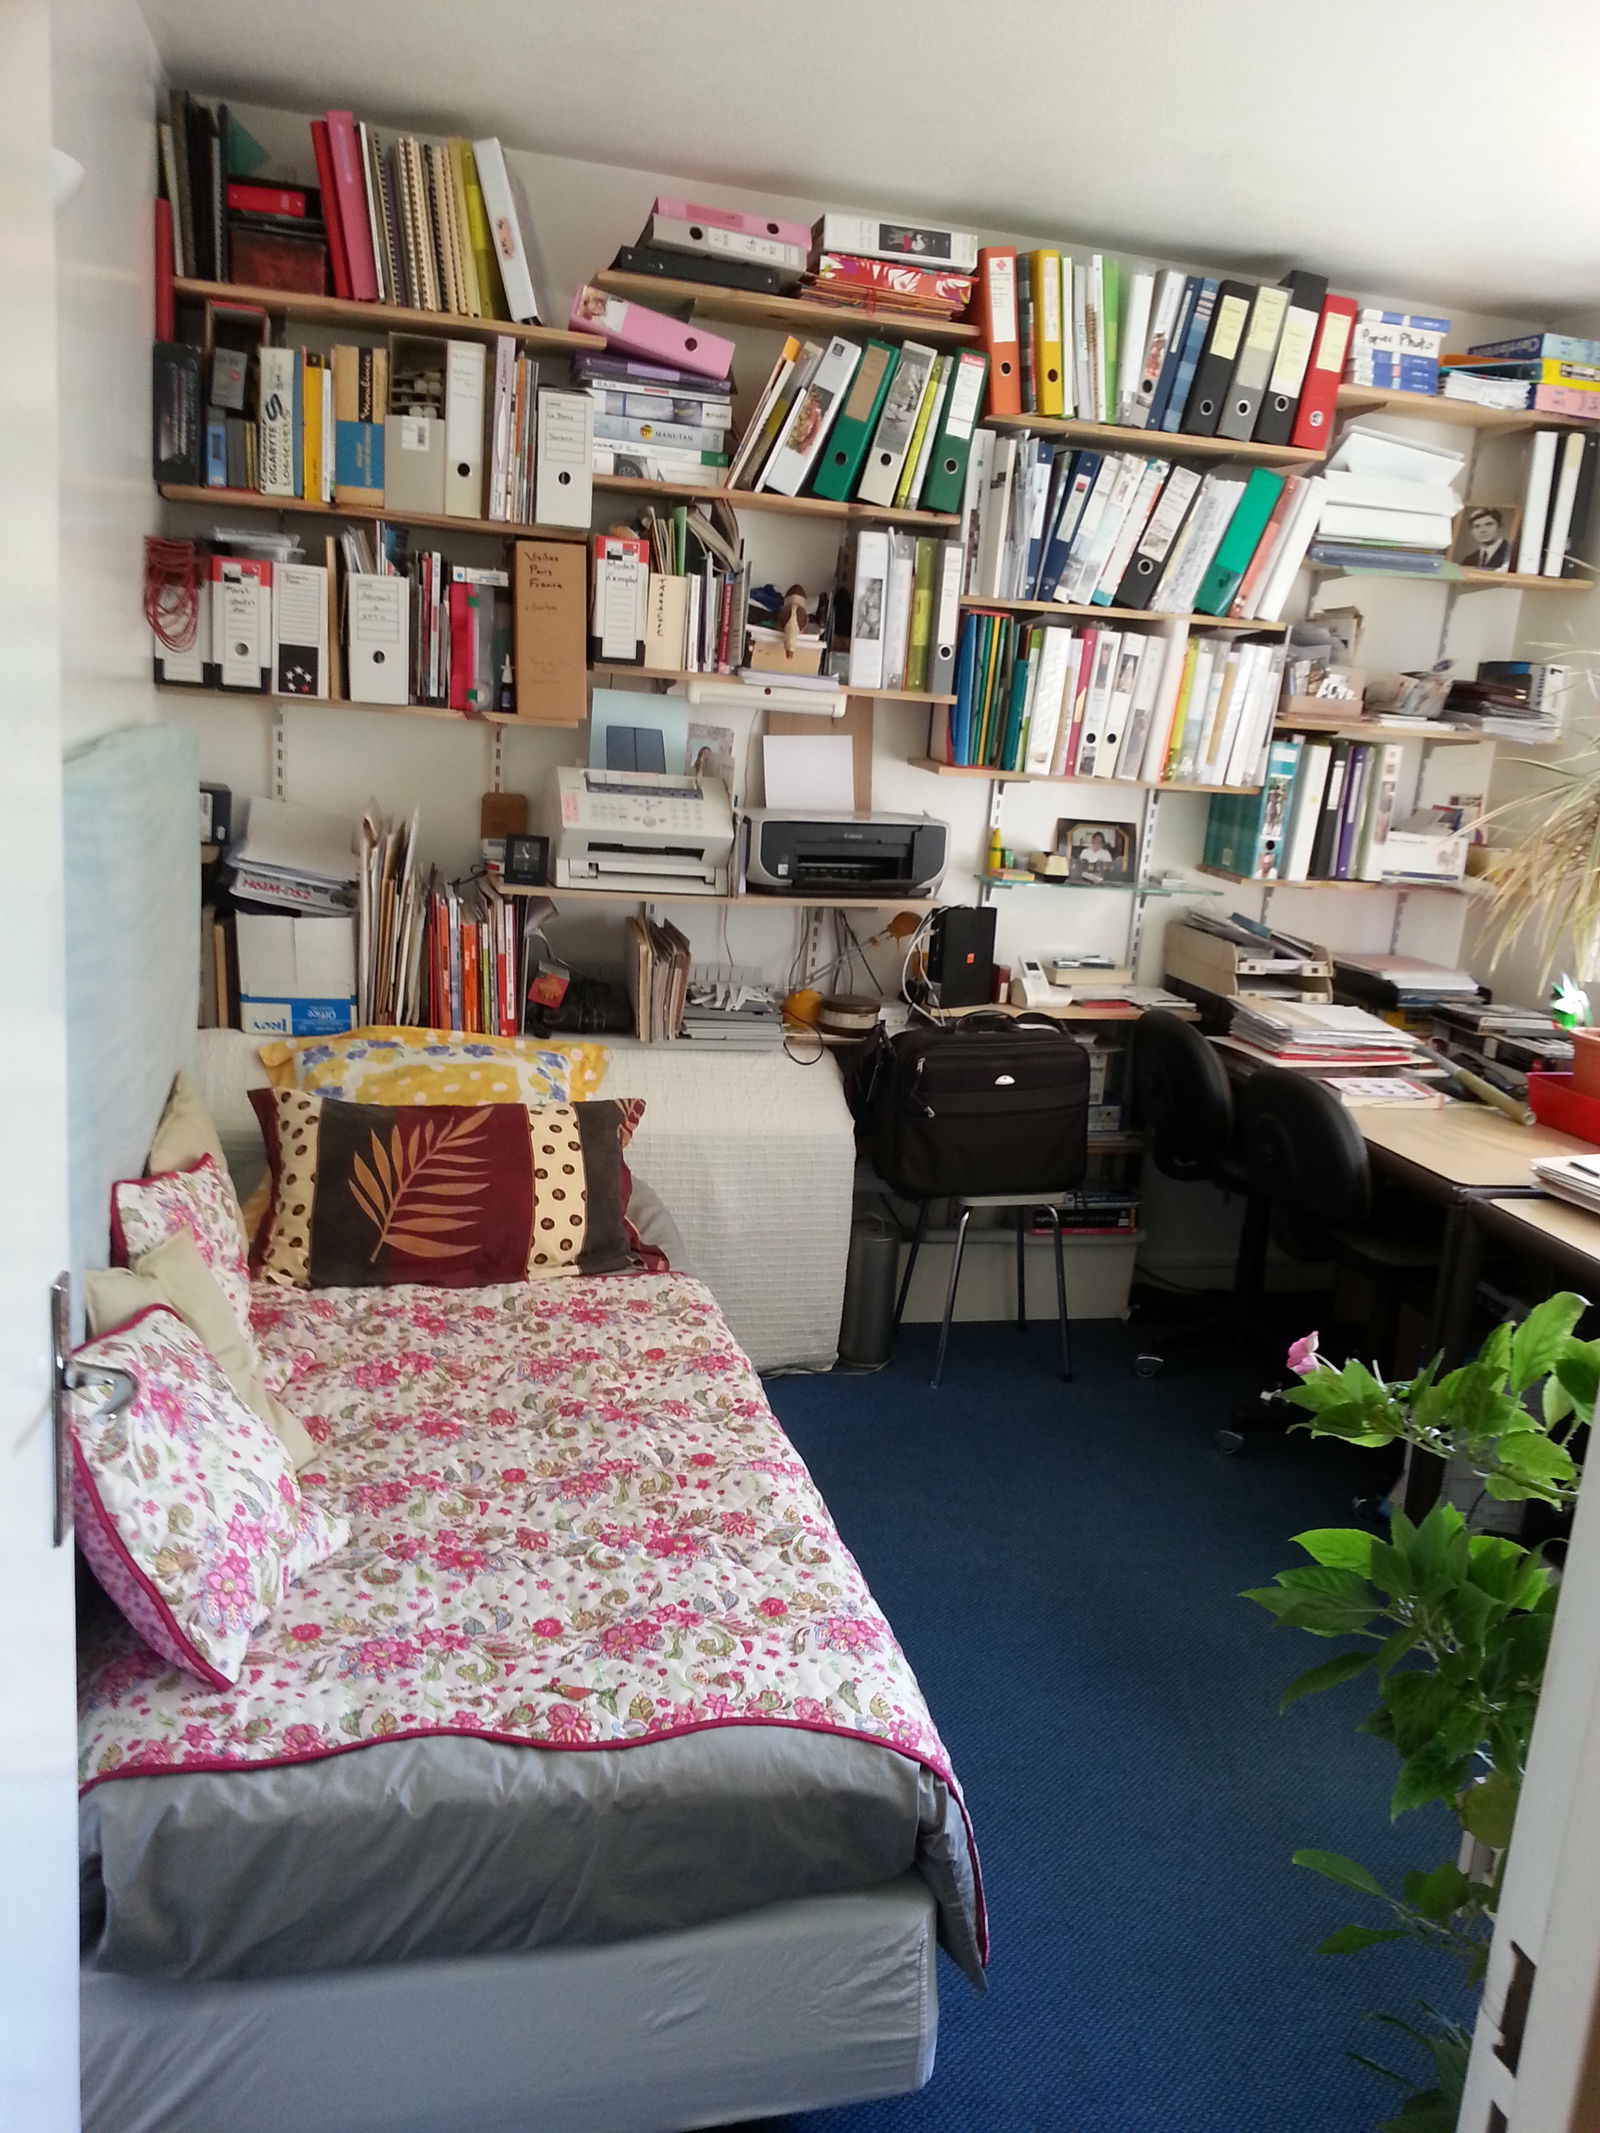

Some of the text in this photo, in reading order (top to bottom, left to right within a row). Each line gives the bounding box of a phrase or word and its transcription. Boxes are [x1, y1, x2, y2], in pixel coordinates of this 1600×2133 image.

[1400, 332, 1434, 350] Photo
[655, 430, 694, 441] MANUTAN
[268, 426, 278, 485] GIGABYTE
